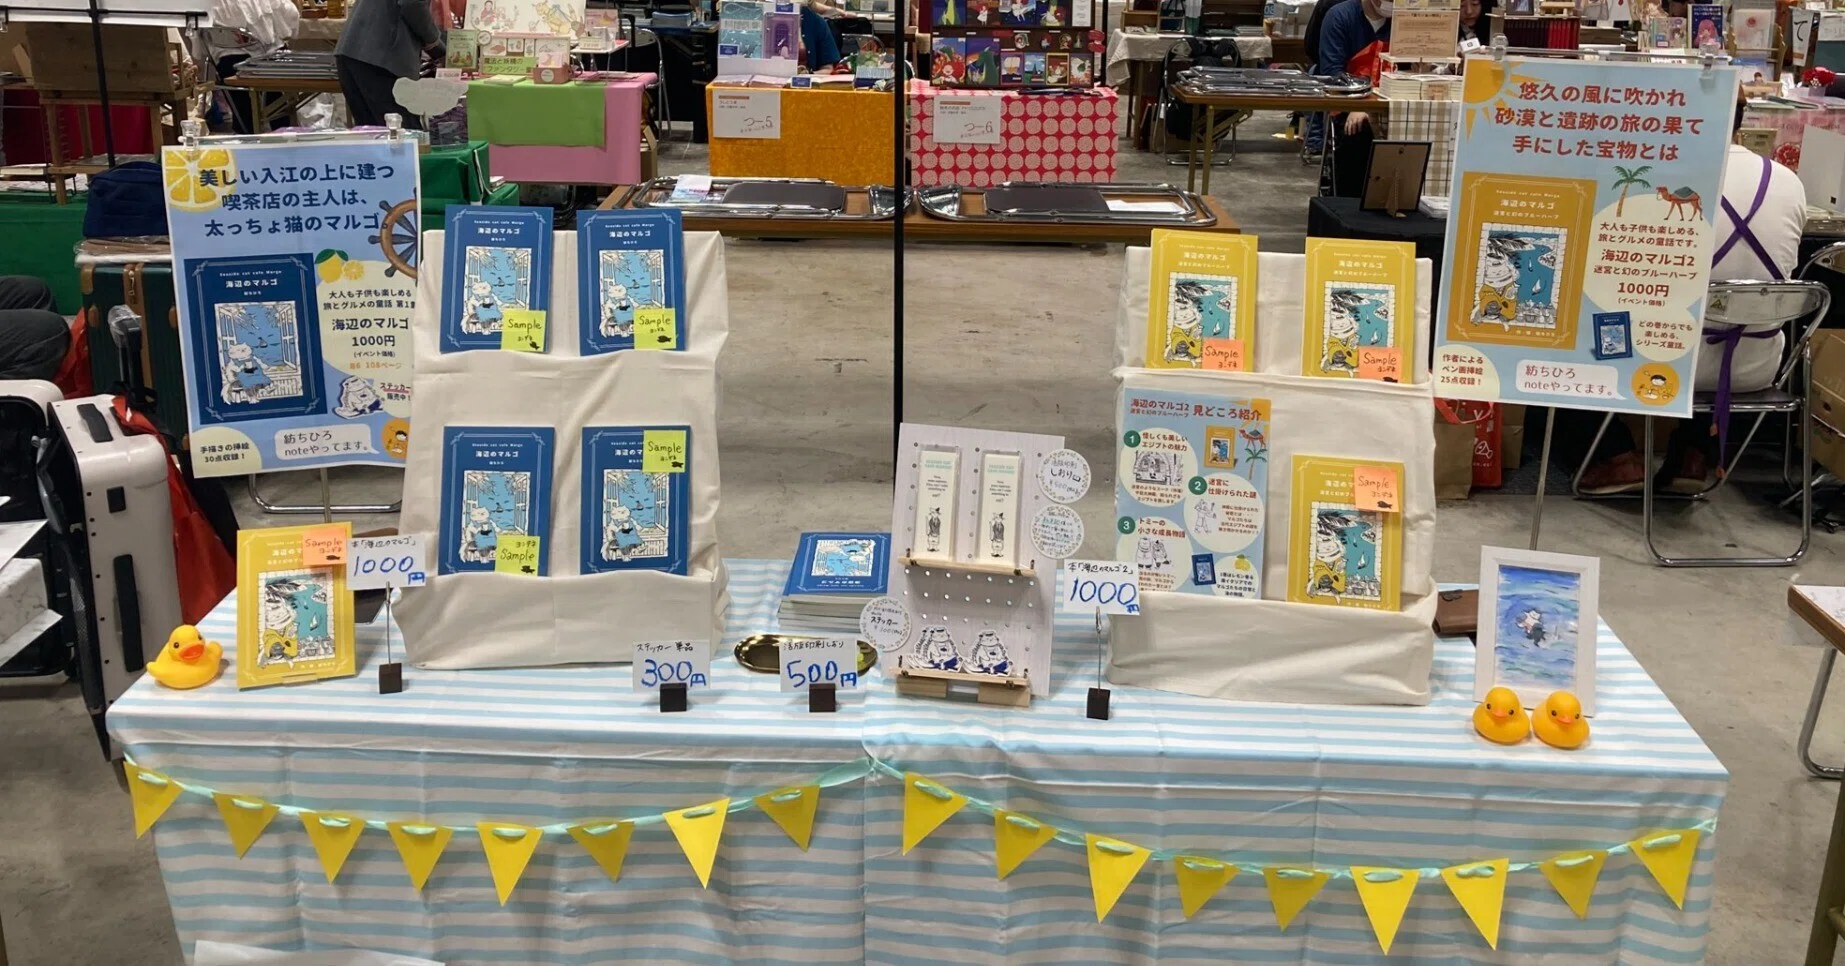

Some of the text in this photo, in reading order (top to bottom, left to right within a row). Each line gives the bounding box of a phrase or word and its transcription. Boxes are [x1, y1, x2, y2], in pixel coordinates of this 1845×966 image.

[1519, 81, 1686, 107] 悠久の風に吹かれ
[1494, 106, 1704, 135] 砂漠と遺跡の旅の果て
[1512, 135, 1679, 162] 手にした宝物とは
[199, 163, 395, 186] 美しい入江の上に建つ
[221, 190, 369, 211] 喫茶店の主人は、
[204, 213, 389, 238] 太っちょ猫のマルゴ。
[1600, 222, 1699, 236] 大人も子供も楽しめる、
[1598, 234, 1697, 248] 旅とグルメの童話です。
[1602, 249, 1695, 266] 海辺のマルゴ2
[226, 278, 278, 288] 海辺のマルゴ
[1618, 282, 1669, 297] 1000円
[323, 300, 392, 310] 旅とグルメの童話
[332, 318, 409, 331] 海辺のマルゴ
[508, 319, 542, 333] Sample
[639, 315, 671, 326] Sample
[1638, 320, 1692, 331] どの巻からでも
[352, 335, 395, 346] 1000円
[1205, 346, 1240, 361] Sample
[1363, 352, 1397, 368] Sample
[1442, 354, 1484, 364] 作者による
[1442, 365, 1484, 376] ペン画挿絵
[1525, 365, 1576, 378] 紡ちひろ
[380, 382, 412, 390] ステッカー
[1524, 381, 1613, 396] noteやってます。
[1130, 398, 1262, 420] 海辺のマルゴ2 見どころ紹介
[284, 430, 332, 444] 紡ちひろ
[1142, 432, 1188, 442] 怪しくも美しい
[200, 442, 250, 454] 手描きの挿絵
[284, 441, 368, 456] noteやってます。
[648, 440, 682, 455] Sample
[1142, 442, 1187, 452] エジプトの魅力
[1358, 476, 1390, 489] Sample
[1140, 516, 1166, 526] トミーの
[305, 538, 342, 550] Sample
[500, 549, 535, 568] Sample
[354, 556, 425, 584] 1000円
[1070, 576, 1140, 613] 1000円
[636, 642, 672, 652] ステッカー
[641, 659, 706, 687] 300円
[786, 660, 857, 688] 500円
